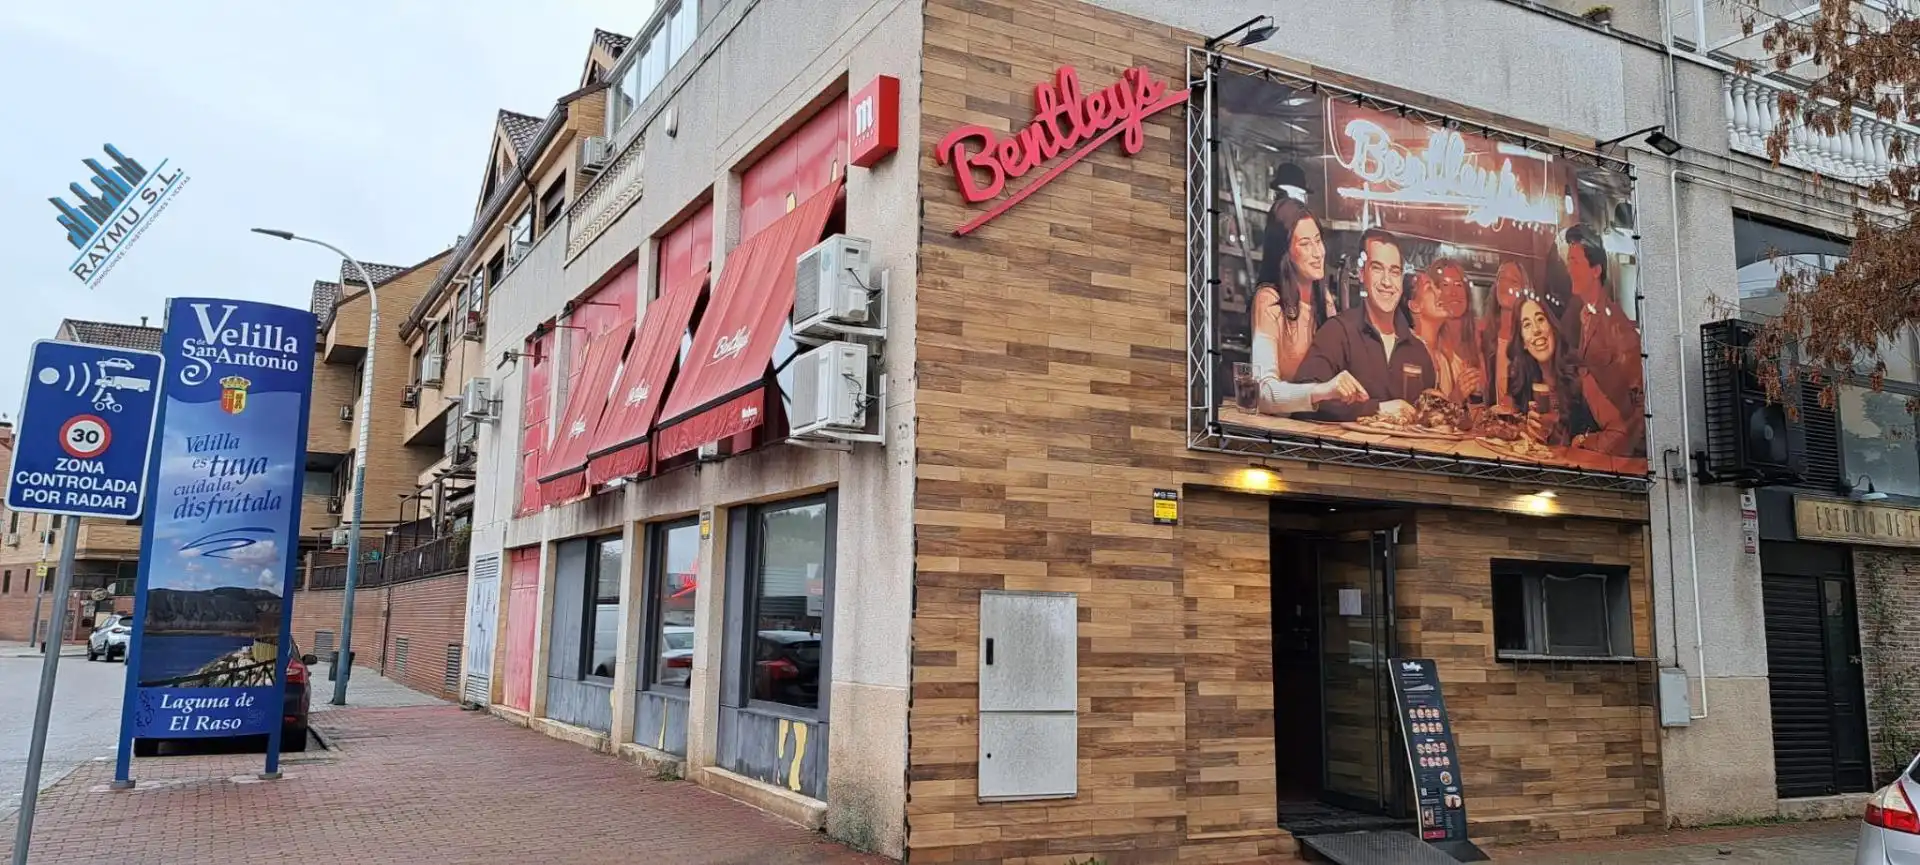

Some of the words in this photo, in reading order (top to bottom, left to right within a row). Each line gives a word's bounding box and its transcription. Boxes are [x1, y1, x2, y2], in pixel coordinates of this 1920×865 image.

[935, 65, 1167, 203] Bentley's
[190, 303, 298, 354] Velilla
[214, 348, 298, 372] Antonio
[71, 428, 99, 444] 30
[186, 432, 240, 453] Velilla
[55, 457, 105, 474] ZONA
[192, 458, 207, 470] es
[209, 454, 268, 485] tuya
[16, 470, 138, 493] CONTROLADA
[22, 488, 61, 504] POR
[65, 491, 127, 509] RADAR
[173, 489, 282, 524] disfrútala
[1816, 506, 1875, 535] ESTUDIO
[160, 693, 229, 713] Laguna
[234, 692, 254, 707] de
[168, 715, 191, 731] El
[194, 715, 242, 731] Raso
